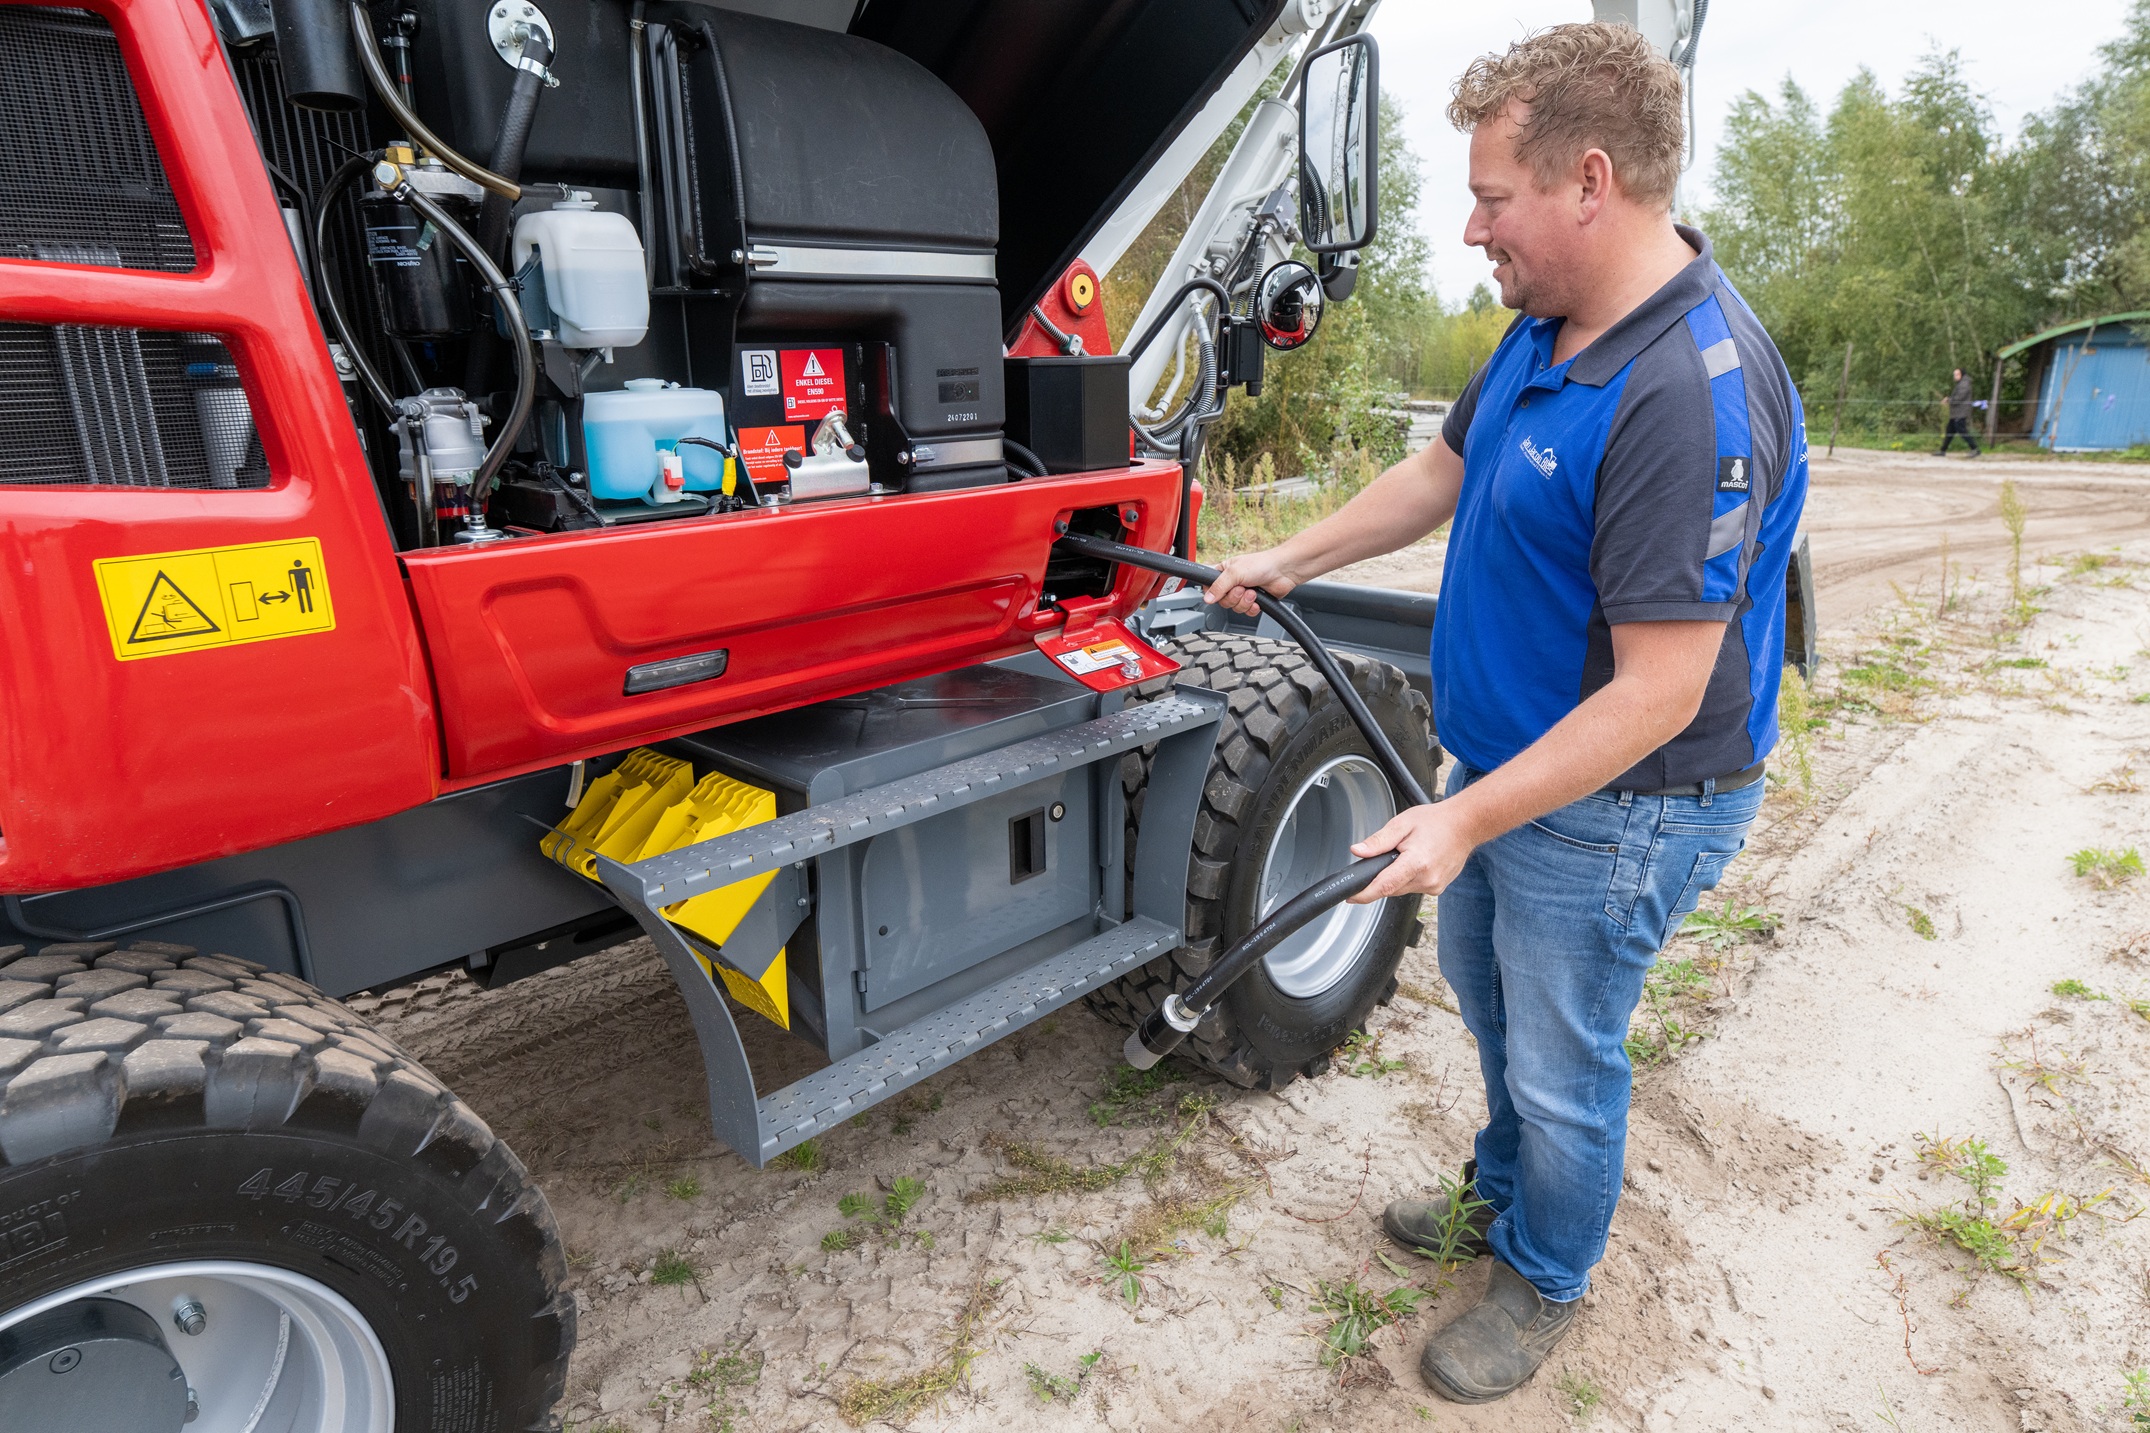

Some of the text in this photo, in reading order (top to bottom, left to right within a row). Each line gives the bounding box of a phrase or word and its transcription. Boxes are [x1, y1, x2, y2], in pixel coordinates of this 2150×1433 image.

[796, 377, 834, 387] ENKEL DIESEL
[807, 388, 824, 396] EN590
[1720, 480, 1749, 490] MASCOT
[1315, 882, 1336, 898] RCL-19
